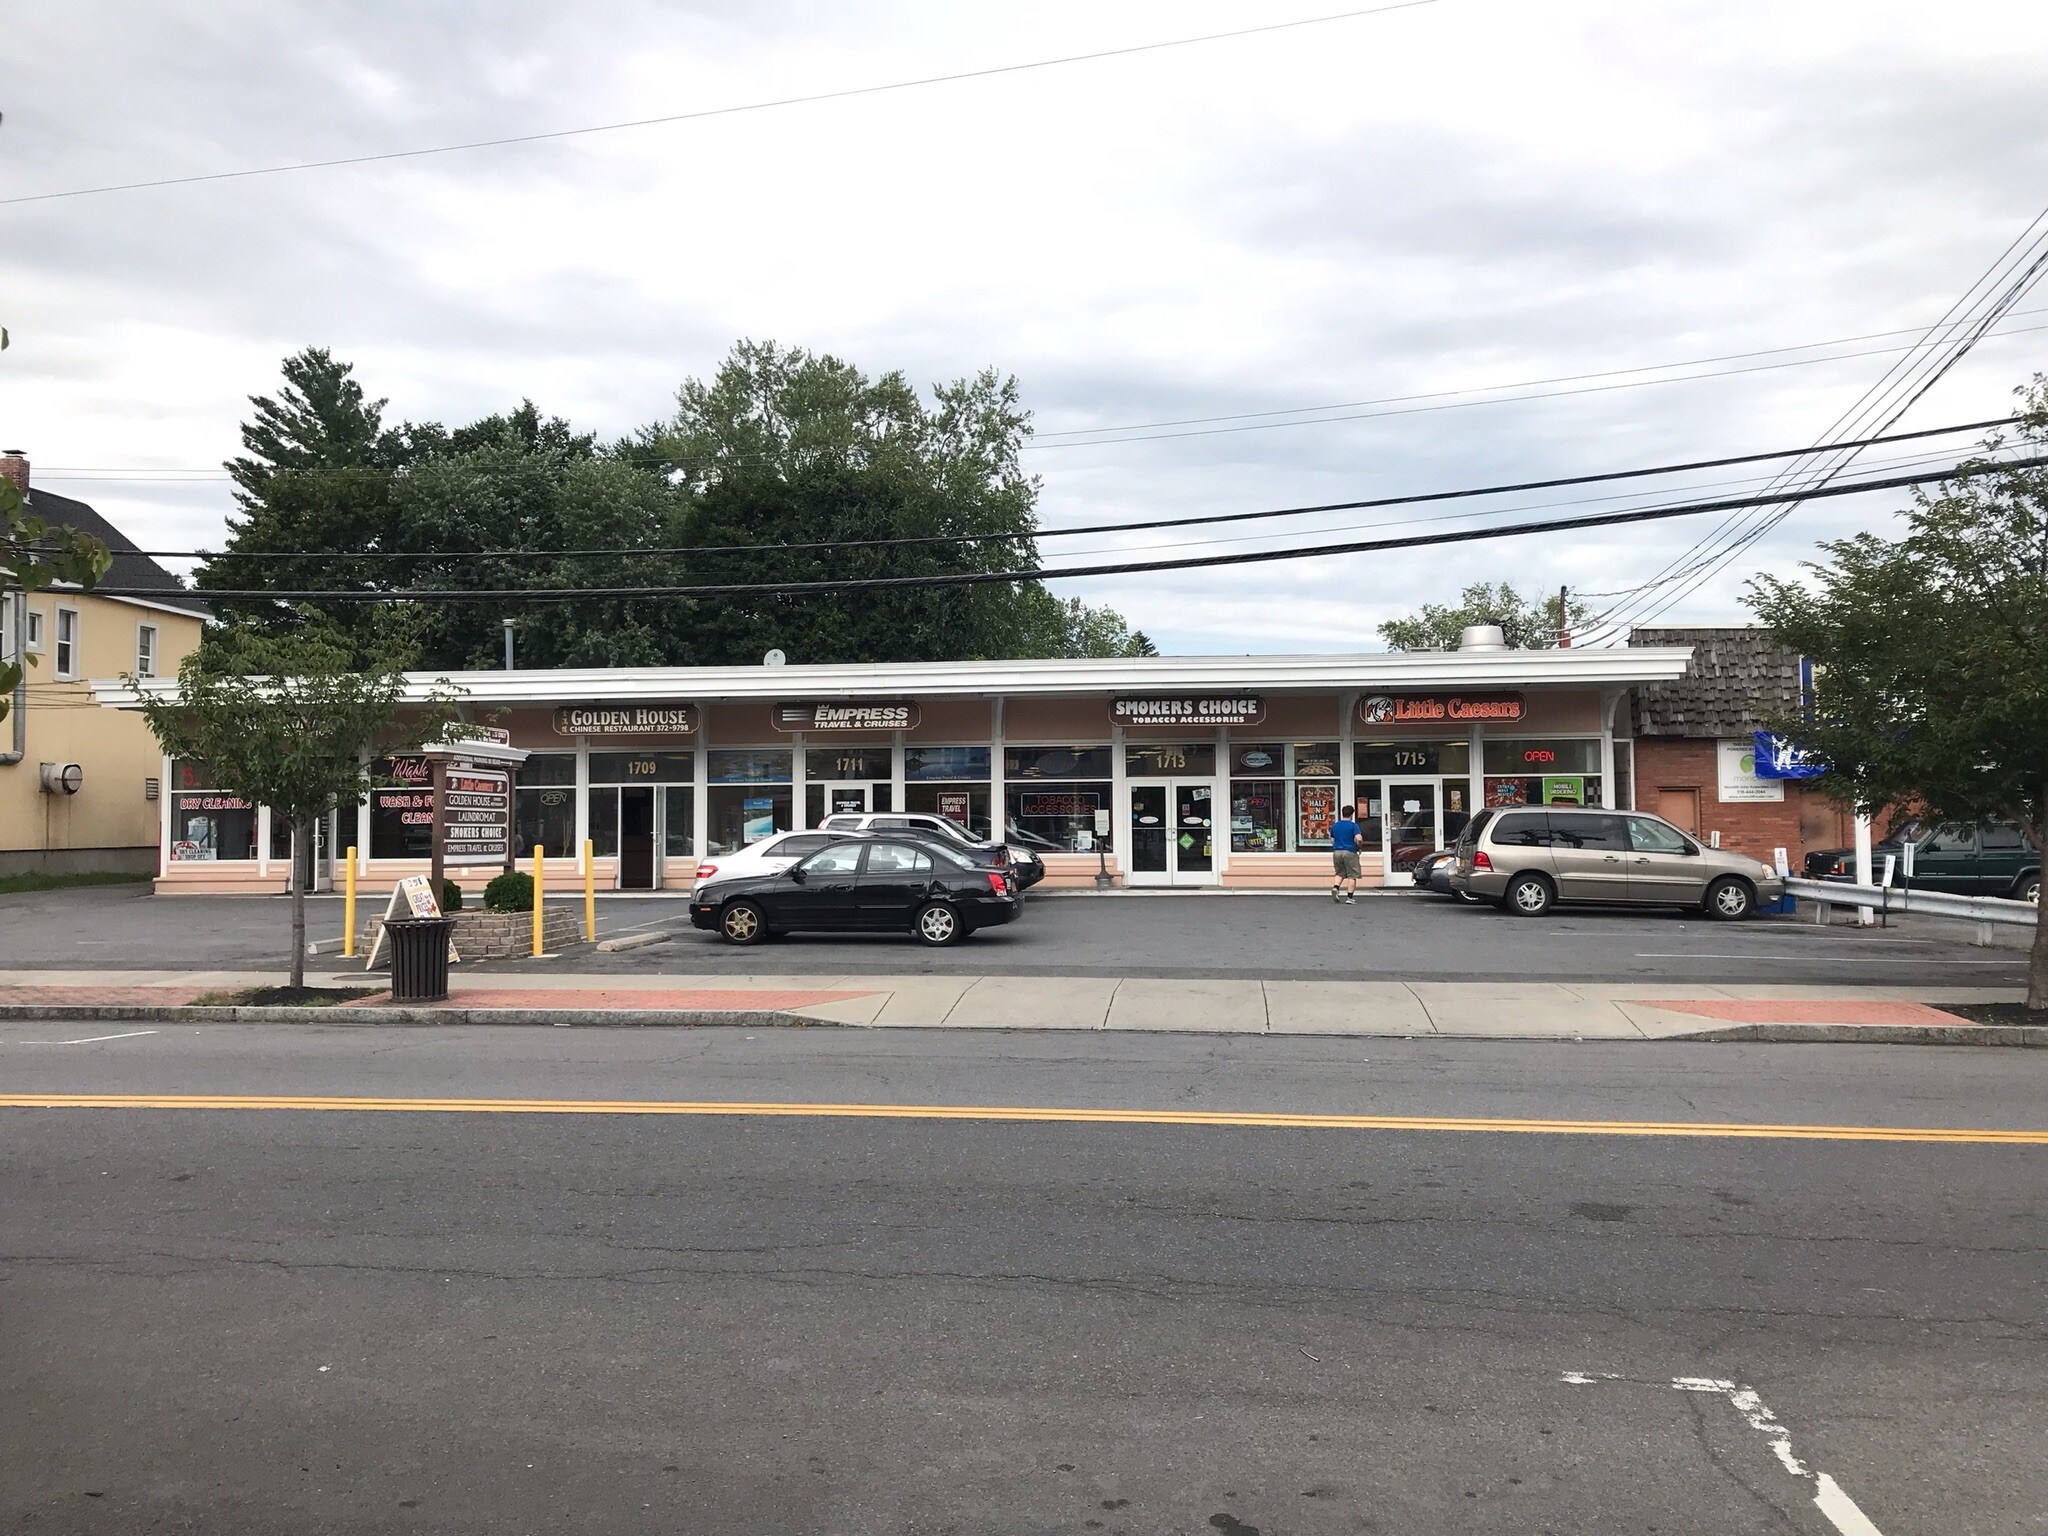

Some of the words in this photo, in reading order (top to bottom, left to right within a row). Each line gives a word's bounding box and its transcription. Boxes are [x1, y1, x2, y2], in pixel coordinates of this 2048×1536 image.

[1115, 700, 1193, 715] SMOKERS
[1198, 699, 1258, 715] CHOICE
[1394, 698, 1445, 719] Little
[1447, 698, 1521, 719] Caesars
[571, 709, 631, 726] GOLDEN
[636, 709, 687, 725] HOUSE
[814, 707, 910, 721] EMPRESS
[570, 725, 602, 733] CHINESE
[604, 725, 656, 733] RESTAURANT
[656, 724, 690, 732] 372-9798
[815, 720, 853, 729] TRAVEL
[854, 720, 862, 728] &
[863, 720, 908, 728] CRUISES
[1157, 755, 1186, 768] 1713
[1395, 752, 1426, 766] 1715
[1524, 751, 1555, 762] OPEN
[628, 761, 657, 774] 1709
[836, 758, 863, 771] 1711
[460, 778, 474, 791] Little
[180, 797, 201, 810] DRY
[380, 795, 411, 808] WASH
[412, 795, 424, 807] &
[449, 794, 472, 806] GOLDEN
[472, 796, 491, 807] HOUSE
[541, 792, 567, 803] OPEN
[941, 797, 967, 805] EMPRESS
[1036, 795, 1085, 805] TOBACCO
[941, 805, 962, 813] TRAVEL
[1024, 805, 1097, 815] ACCESSORIES
[458, 811, 497, 822] LAUNDROMAT
[450, 826, 480, 838] SMOKERS
[481, 827, 502, 838] CHOICE
[447, 844, 467, 853] EMPRESS
[467, 844, 483, 852] TRAVEL
